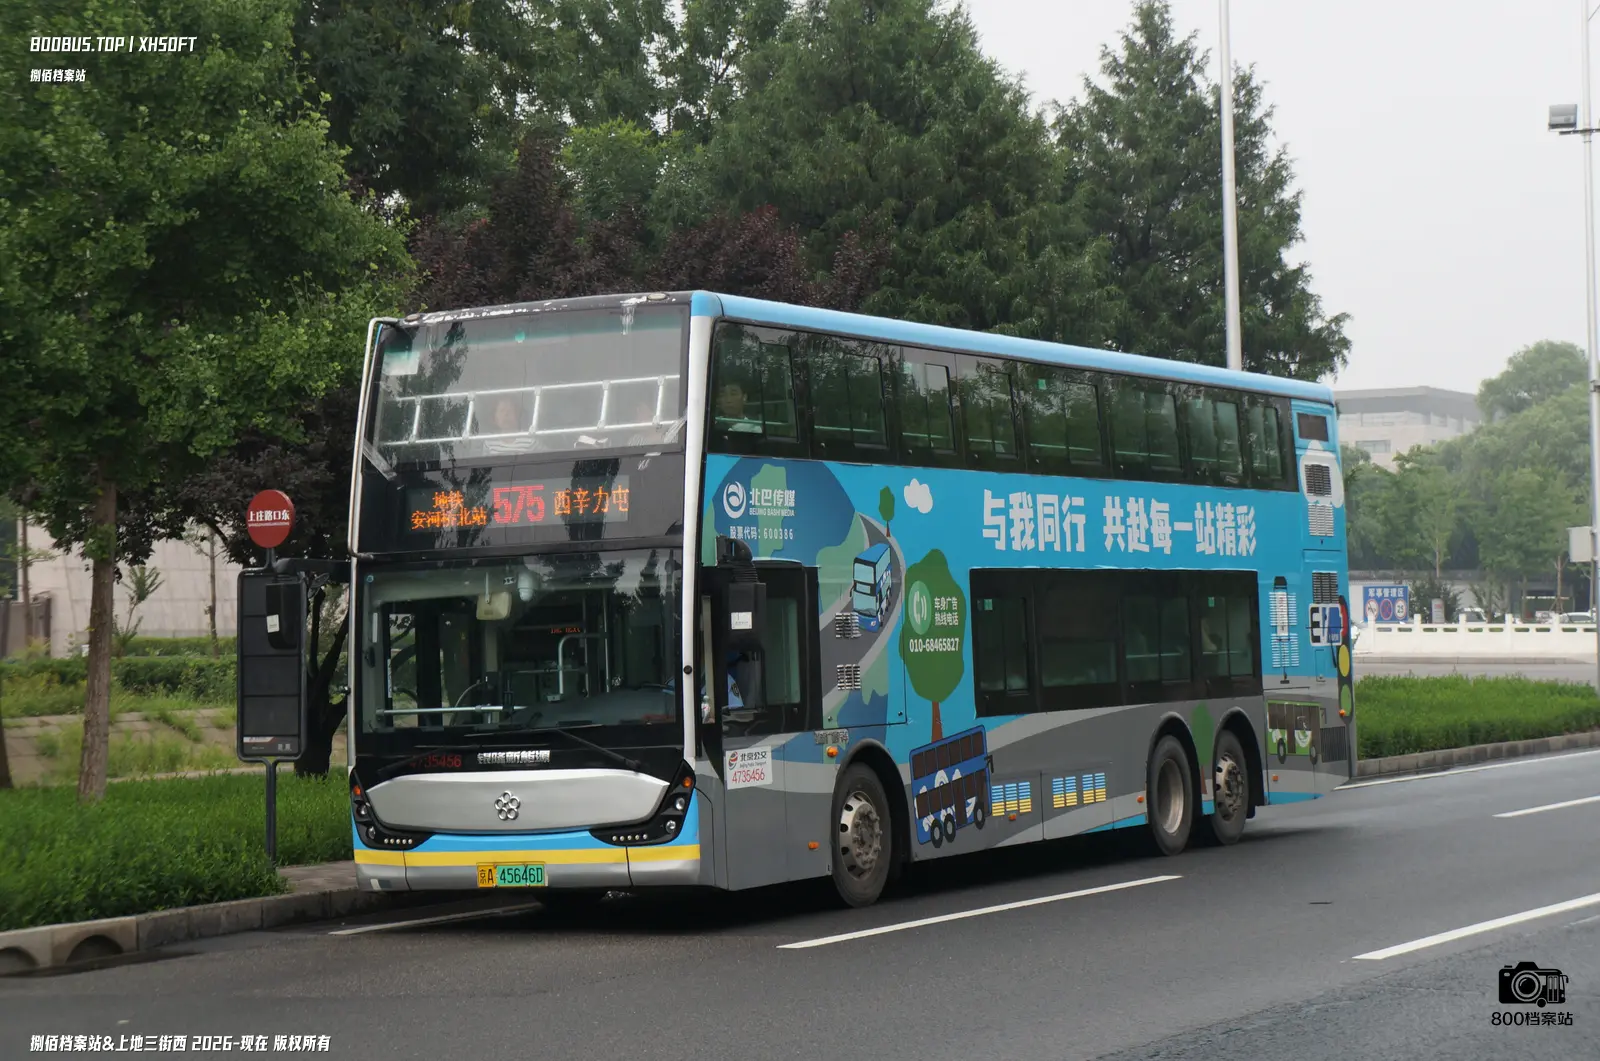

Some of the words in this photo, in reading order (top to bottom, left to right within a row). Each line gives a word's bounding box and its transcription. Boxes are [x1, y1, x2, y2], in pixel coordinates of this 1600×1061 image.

[432, 490, 464, 508] 地铁
[492, 484, 545, 524] 575
[749, 488, 795, 507] 北巴传媒
[248, 510, 290, 522] 上庄路口东
[982, 489, 1086, 552] 与我同行
[1102, 495, 1257, 557] 共赴每一站精彩
[934, 596, 958, 611] 车身广告
[934, 612, 959, 626] 热线电话
[909, 637, 960, 652] 010-68465827
[740, 751, 766, 761] 北京公交
[731, 768, 765, 784] 4735456
